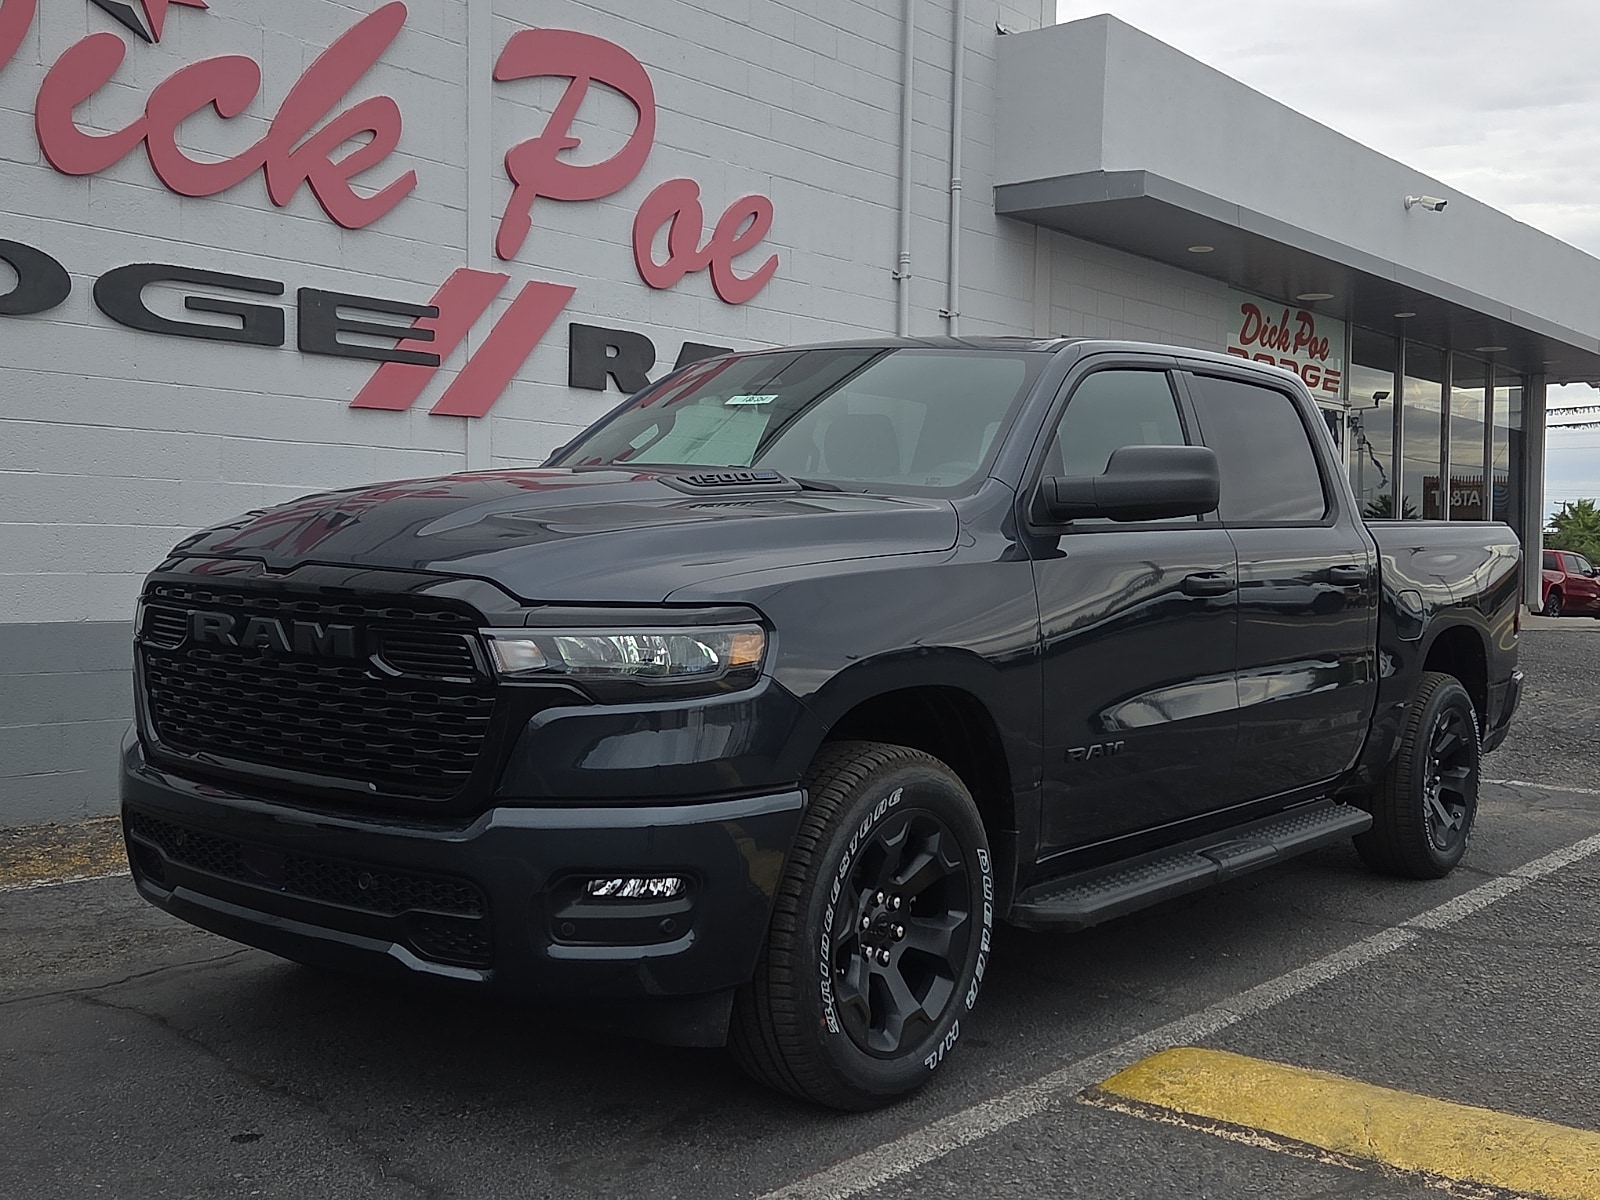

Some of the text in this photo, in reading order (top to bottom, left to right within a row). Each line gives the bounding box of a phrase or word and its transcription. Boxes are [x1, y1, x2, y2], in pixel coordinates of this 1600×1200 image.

[0, 1, 779, 304] ick Poe
[1240, 302, 1330, 361] Dick Poe
[186, 609, 355, 658] RAM
[1064, 741, 1124, 763] RAM
